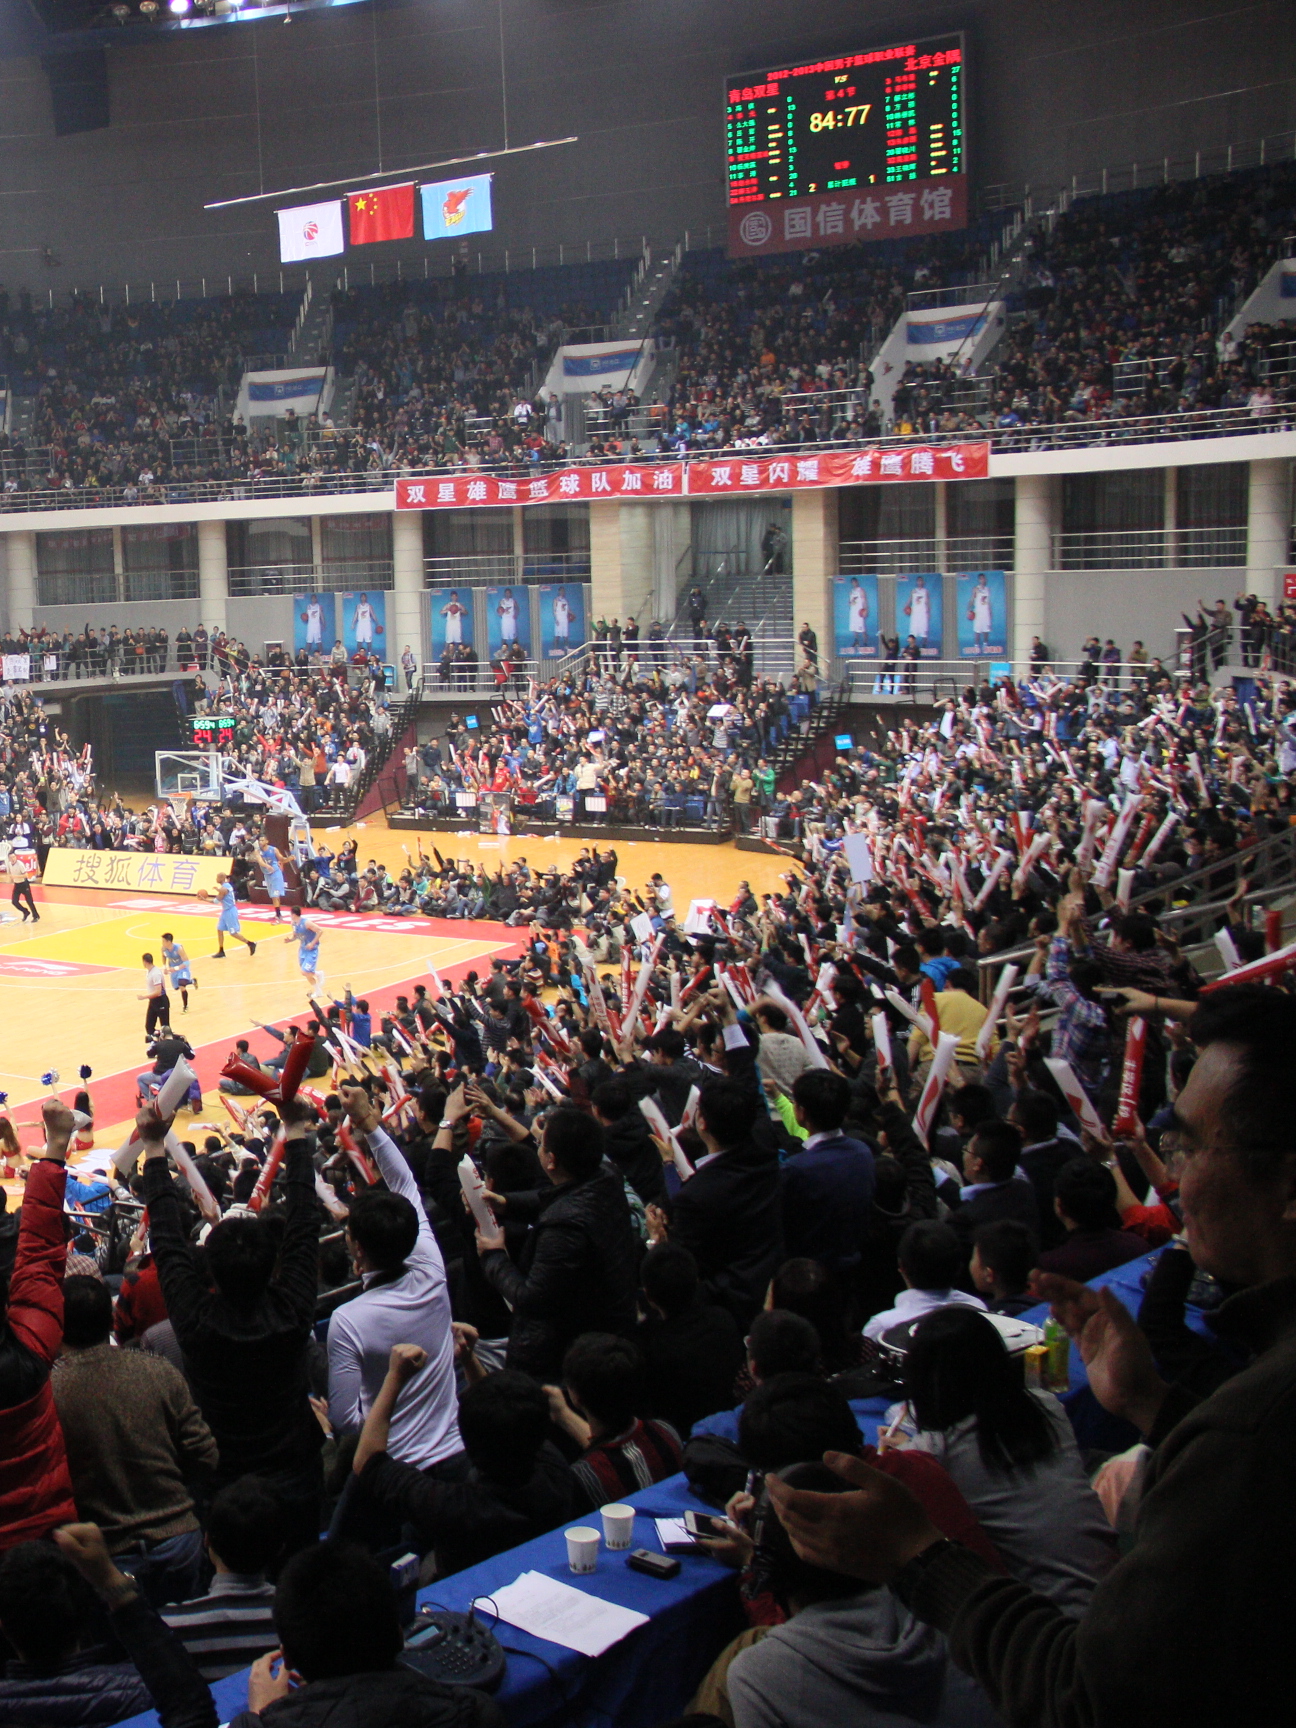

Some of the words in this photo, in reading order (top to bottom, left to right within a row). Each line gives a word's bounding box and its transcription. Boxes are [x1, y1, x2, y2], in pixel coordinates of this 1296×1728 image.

[904, 49, 962, 72] 北京金隅
[728, 83, 780, 103] 青岛双星
[809, 103, 872, 132] 84:77
[808, 182, 818, 193] 2
[868, 174, 876, 184] 1
[784, 187, 953, 241] 国信体育馆
[711, 460, 820, 487] 双星闪耀
[851, 450, 966, 478] 雄鹰腾飞
[406, 468, 675, 504] 双星雄鹰篮球队加油
[194, 729, 213, 744] 24
[218, 728, 233, 743] 24
[73, 854, 201, 891] 搜狐体育
